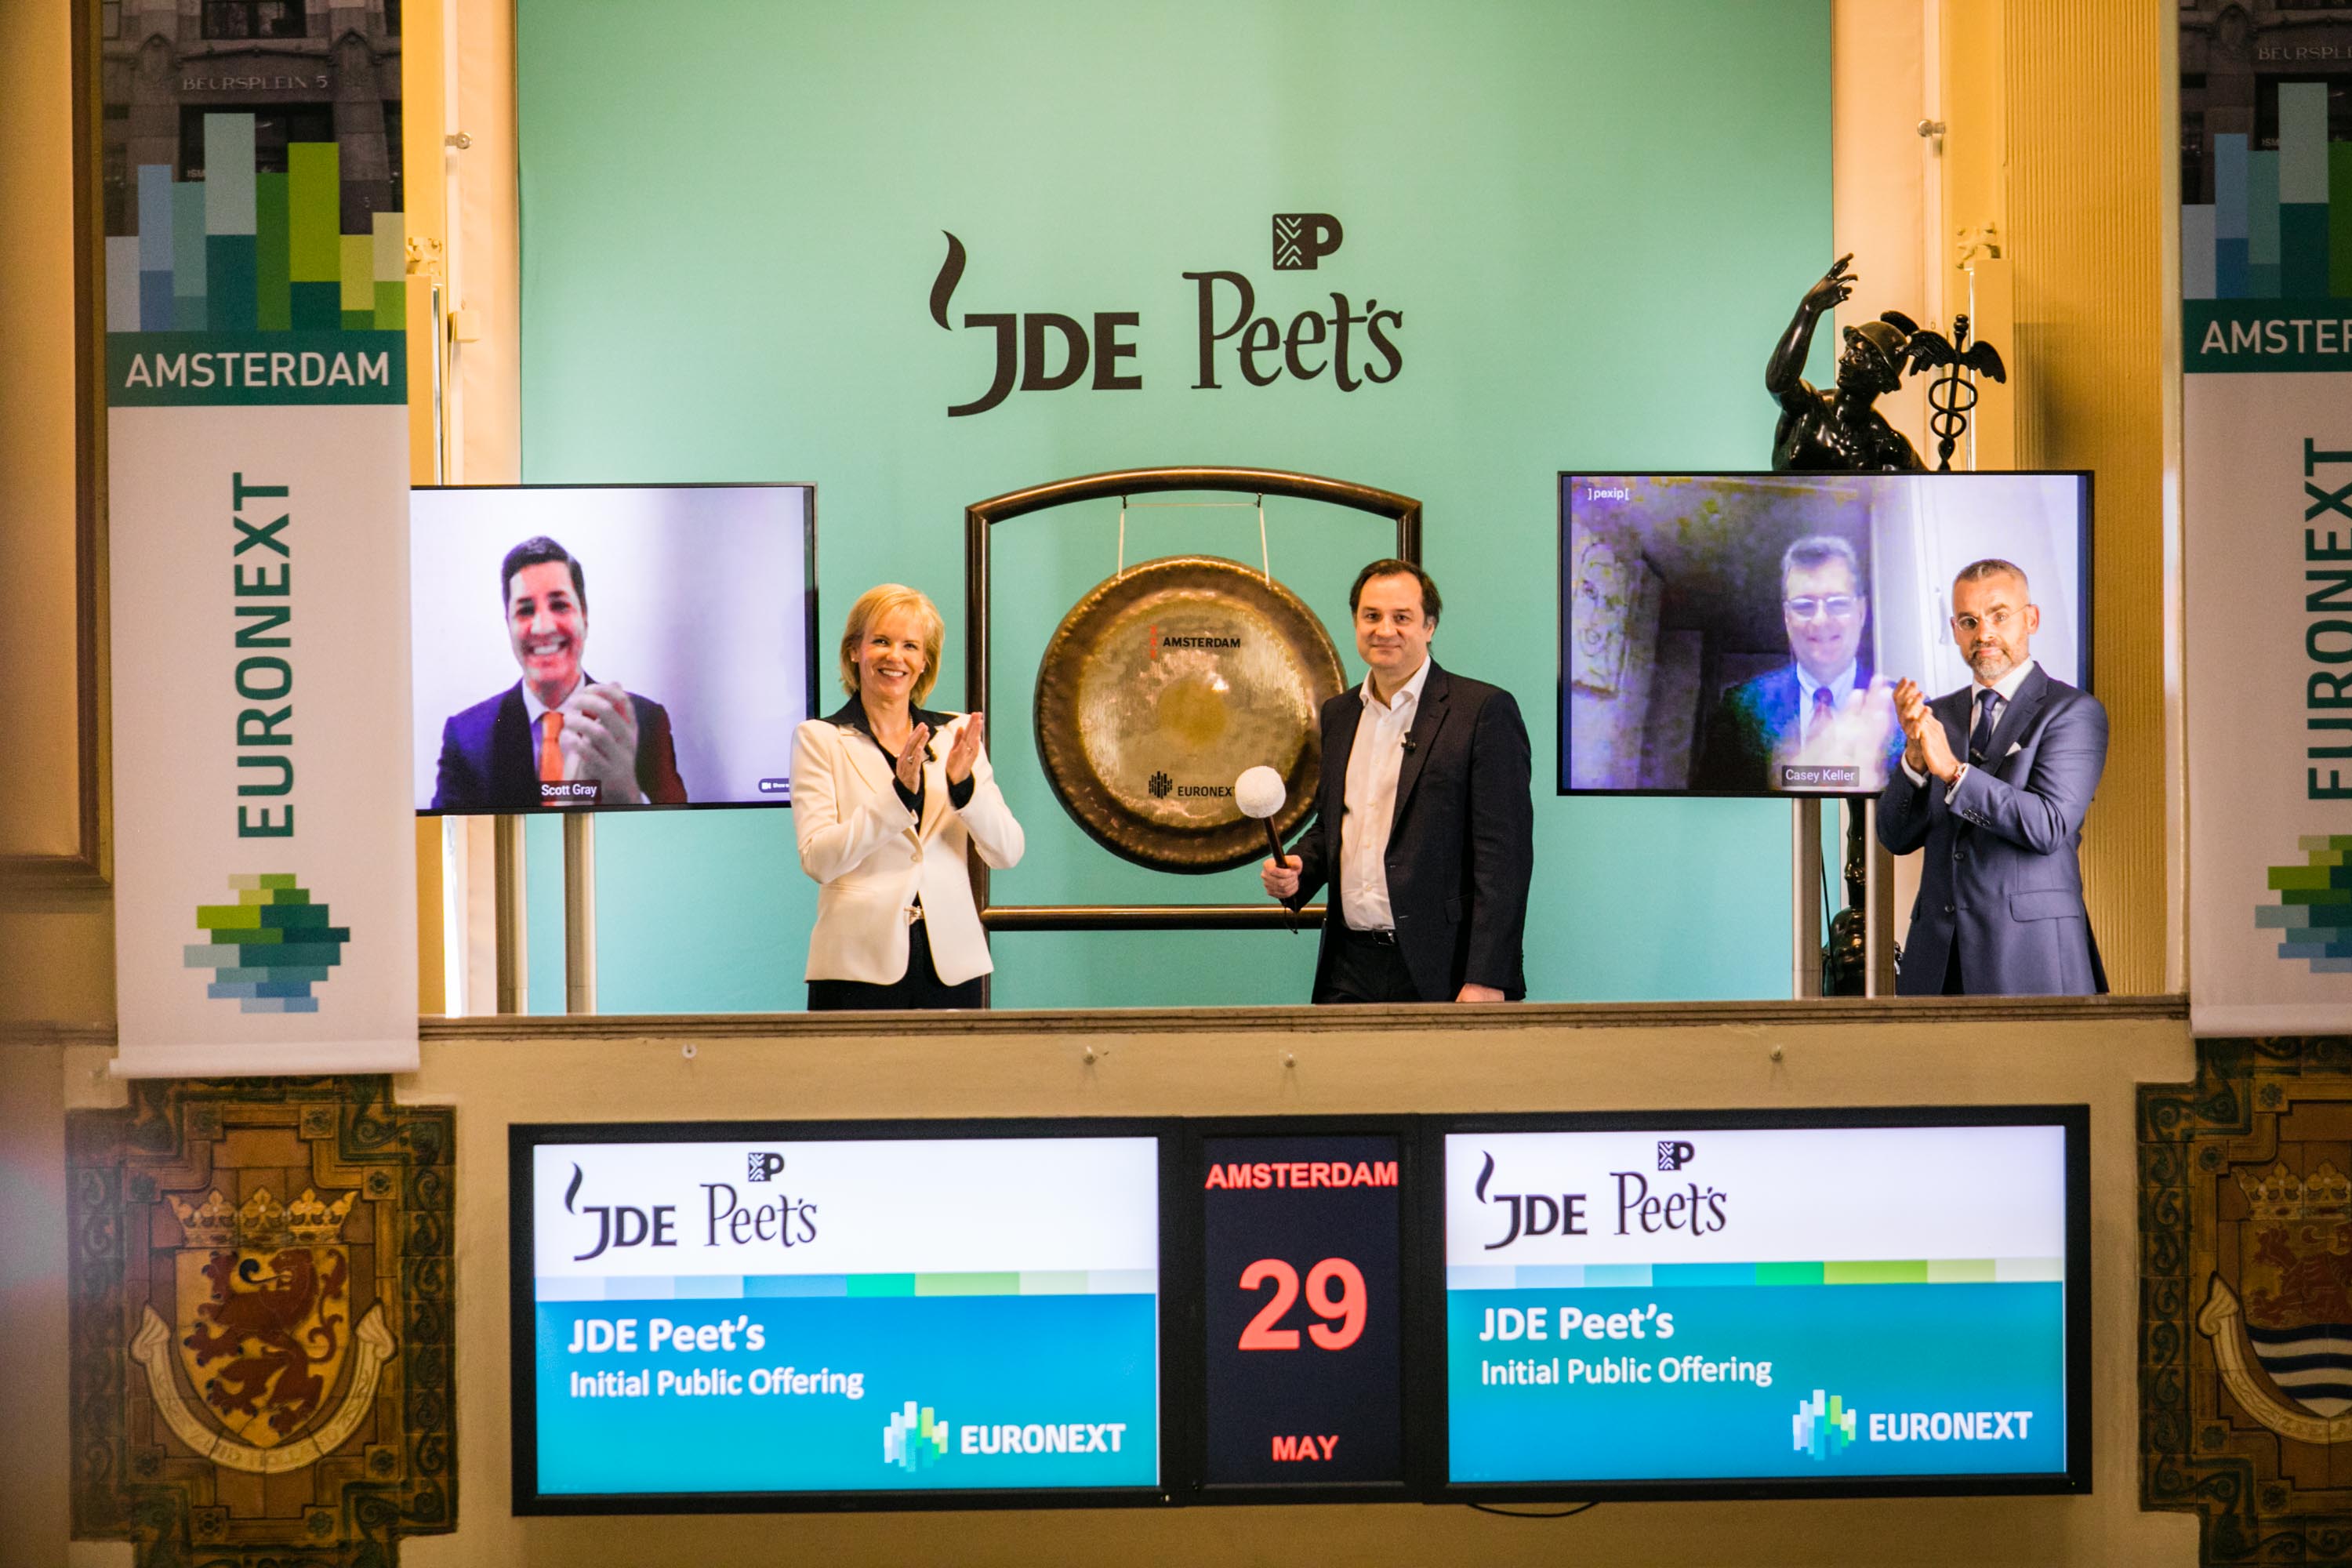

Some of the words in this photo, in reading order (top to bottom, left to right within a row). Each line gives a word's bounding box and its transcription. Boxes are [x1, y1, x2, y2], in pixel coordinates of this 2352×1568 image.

[183, 77, 307, 90] BEURSPLEIN
[316, 75, 328, 88] 5
[947, 312, 1142, 417] JDE
[1182, 270, 1403, 392] Peet's
[125, 352, 390, 388] AMSTERDAM
[2304, 437, 2352, 800] EURONEXT
[232, 472, 295, 838] EURONEXT
[1163, 637, 1241, 648] AMSTERDAM
[541, 783, 570, 796] Scott
[572, 783, 597, 797] Gray
[1785, 768, 1820, 783] Casey
[1822, 769, 1856, 781] Keller
[1205, 1162, 1399, 1190] AMSTERDAM
[573, 1205, 677, 1262] JDE
[699, 1182, 818, 1248] Peet's
[1484, 1193, 1588, 1251] JDE
[1610, 1171, 1727, 1237] Peet's
[1239, 1258, 1369, 1351] 29
[568, 1319, 638, 1354] JDE
[649, 1315, 767, 1353] Peet’s
[1479, 1308, 1548, 1342] JDE
[1559, 1303, 1675, 1341] Peet’s
[571, 1370, 651, 1398] Initial
[657, 1369, 743, 1397] Public
[748, 1367, 866, 1401] Offering
[1482, 1358, 1560, 1386] Initial
[1568, 1357, 1653, 1385] Public
[1659, 1355, 1773, 1388] Offering
[960, 1423, 1127, 1455] EURONEXT
[1869, 1411, 2034, 1443] EURONEXT
[1272, 1436, 1340, 1462] MAY
